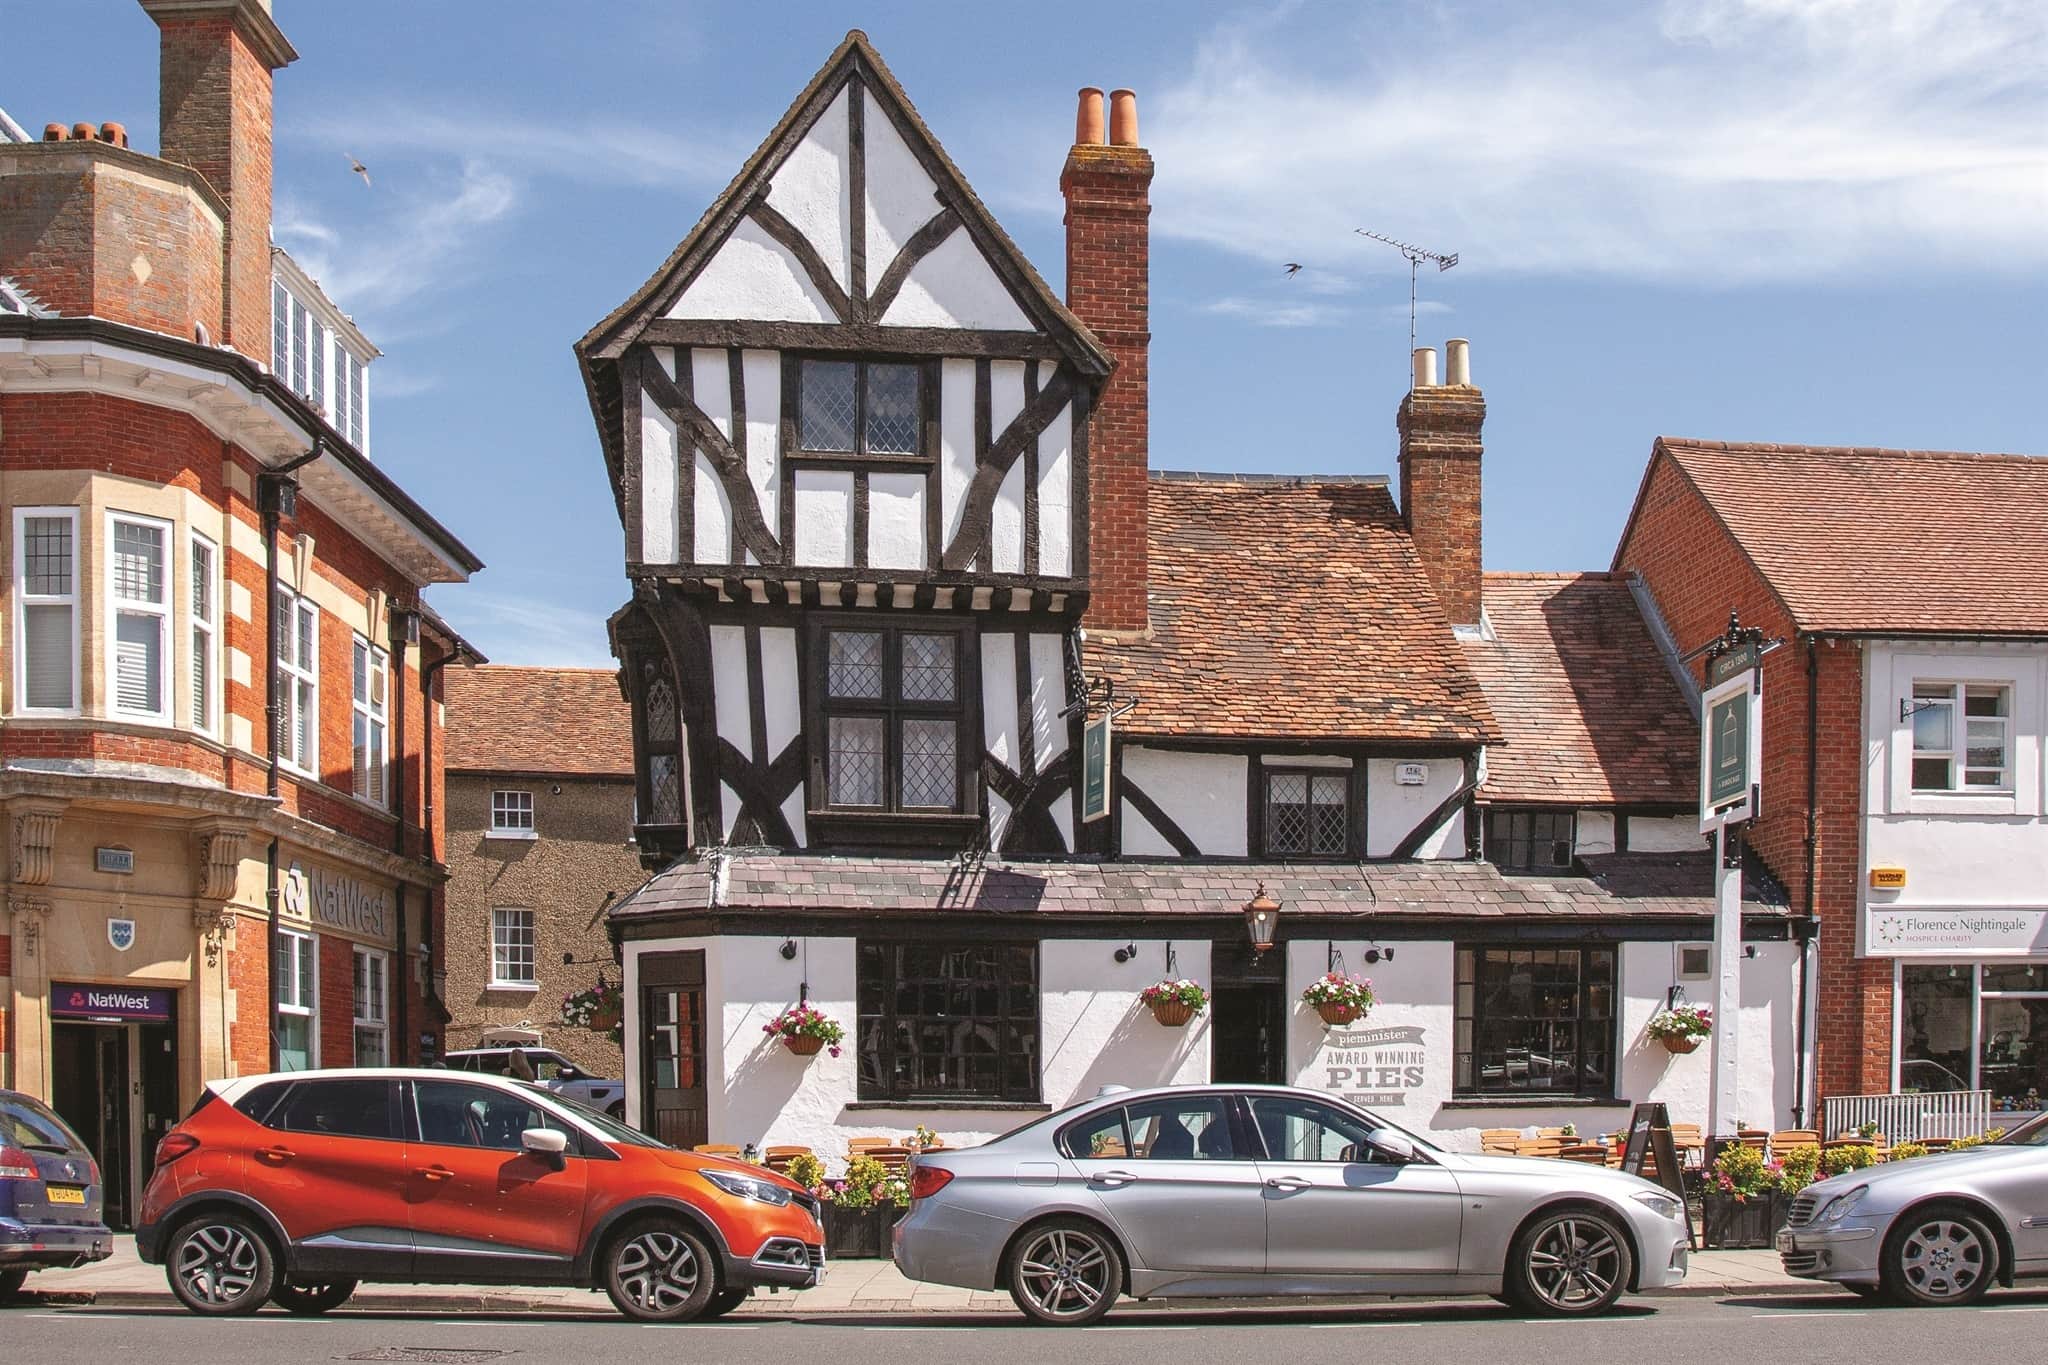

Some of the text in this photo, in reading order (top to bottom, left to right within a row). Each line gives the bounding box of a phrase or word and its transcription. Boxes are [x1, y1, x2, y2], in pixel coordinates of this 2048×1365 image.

[310, 867, 386, 936] NatWest
[1906, 918, 2026, 933] Florence Nightingale
[1940, 935, 1973, 943] CHARITY
[88, 992, 150, 1010] NatWest
[1338, 1029, 1409, 1047] pieminister
[1326, 1050, 1425, 1065] AWARD WINNING
[1326, 1066, 1424, 1089] PIES
